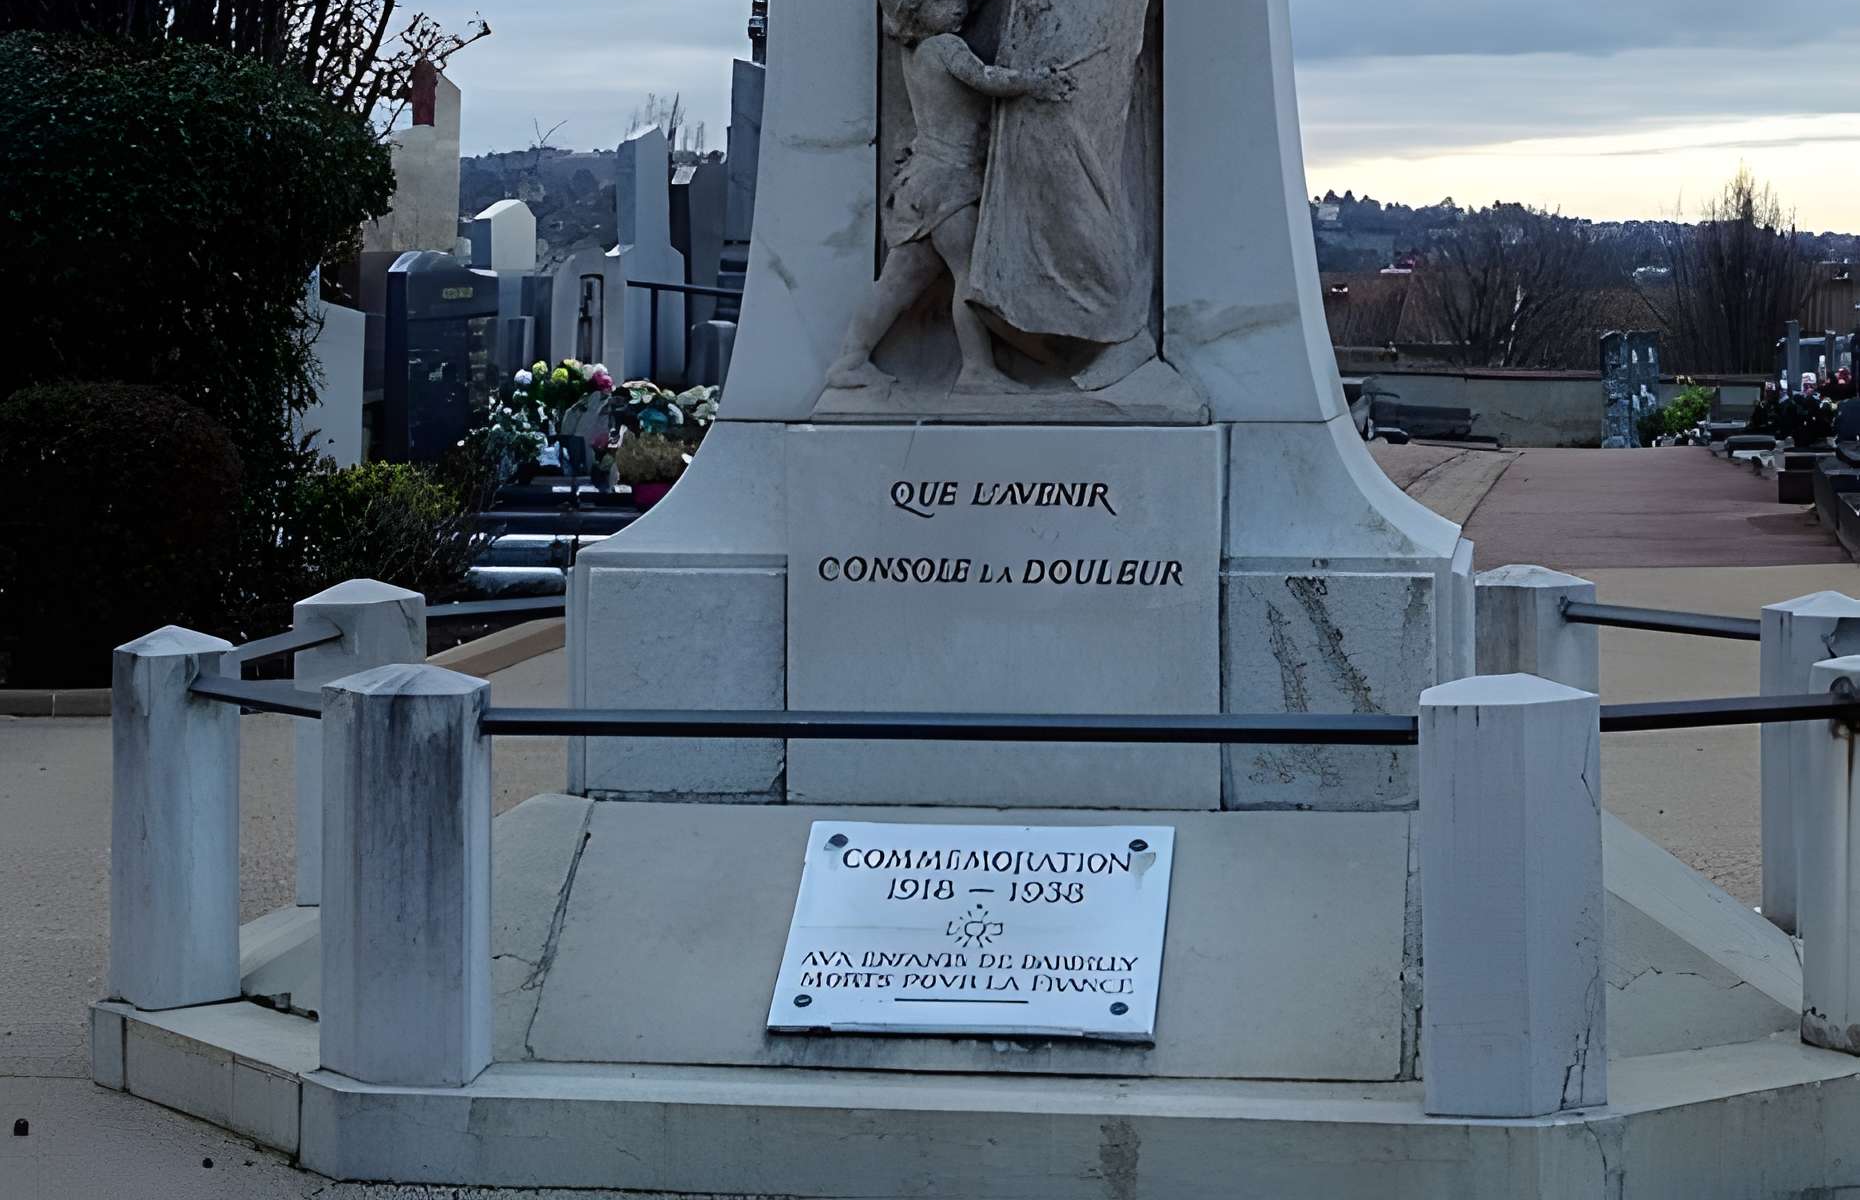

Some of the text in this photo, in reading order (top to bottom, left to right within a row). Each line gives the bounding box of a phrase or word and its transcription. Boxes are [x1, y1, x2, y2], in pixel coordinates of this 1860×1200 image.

[890, 481, 1117, 519] QUE L'AVENIR
[818, 555, 1184, 587] CONSOLE LA DOULEUR
[887, 878, 955, 900] 1918
